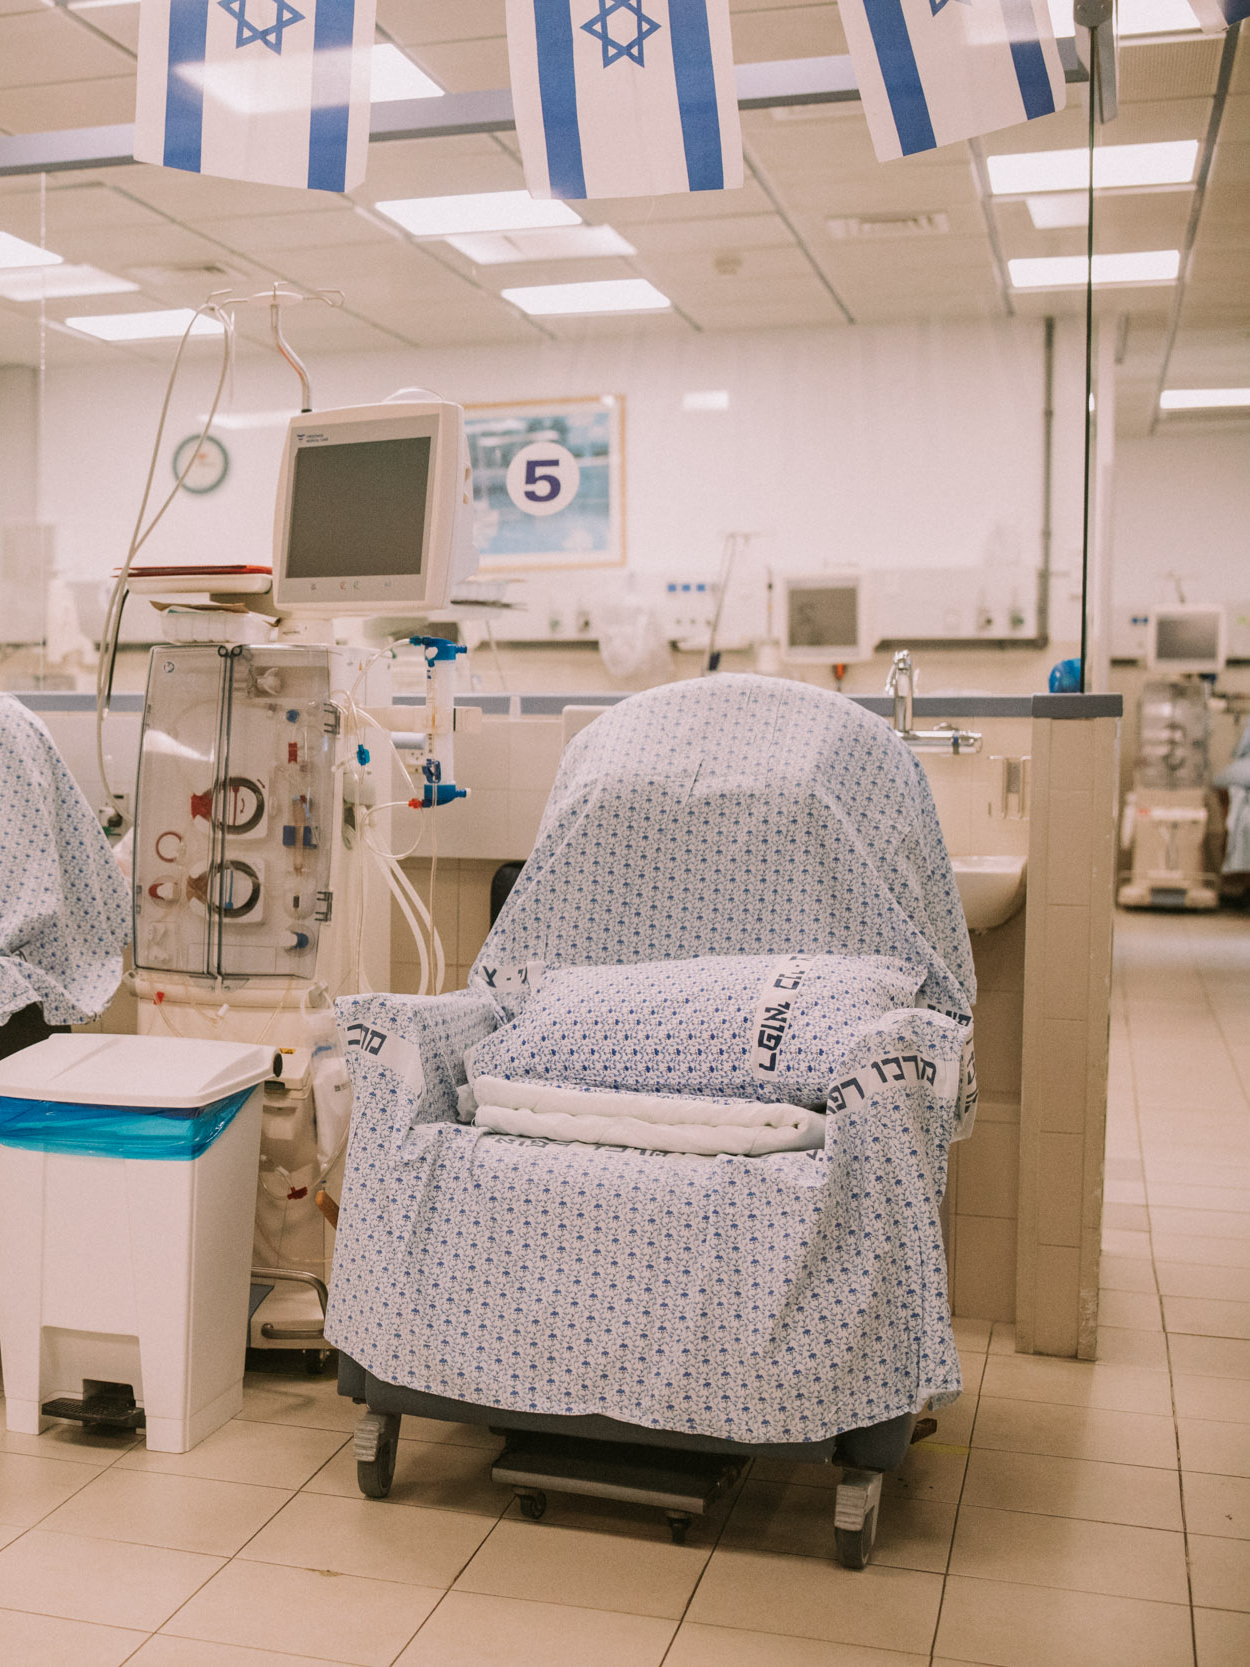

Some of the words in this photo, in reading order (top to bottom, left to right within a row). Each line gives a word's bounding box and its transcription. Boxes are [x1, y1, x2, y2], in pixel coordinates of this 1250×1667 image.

[524, 459, 561, 503] 5
[347, 1023, 388, 1056] מרכ
[757, 1001, 791, 1072] רפואי
